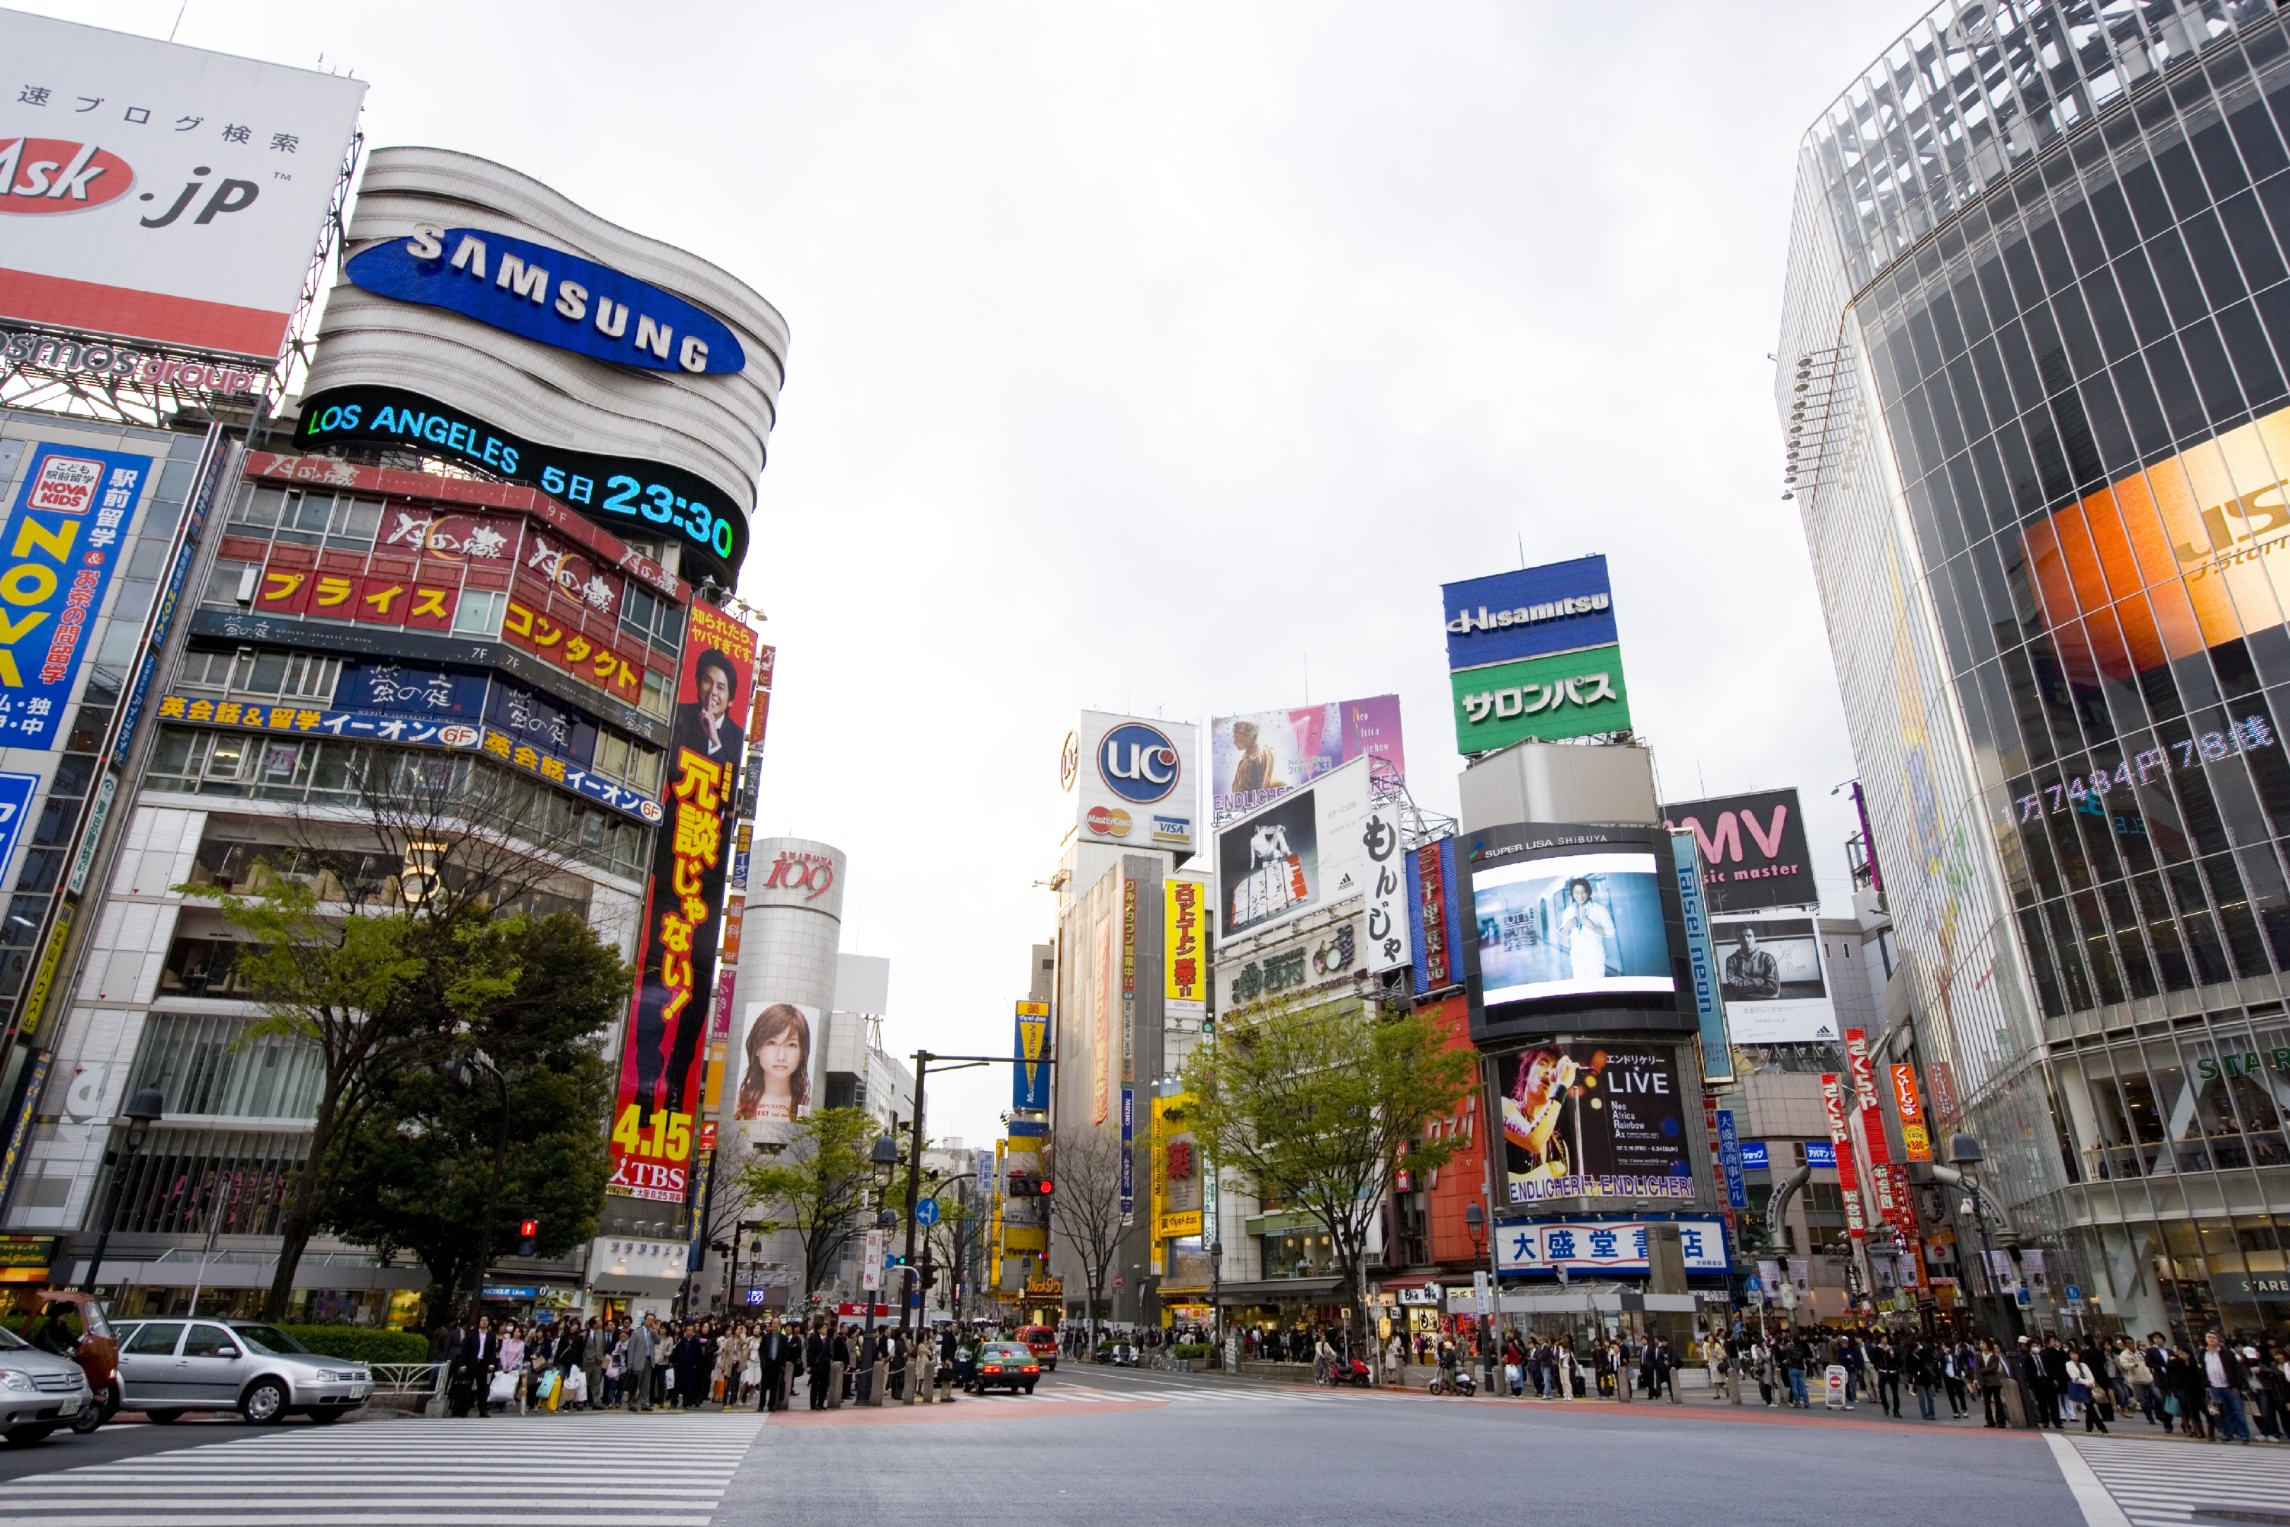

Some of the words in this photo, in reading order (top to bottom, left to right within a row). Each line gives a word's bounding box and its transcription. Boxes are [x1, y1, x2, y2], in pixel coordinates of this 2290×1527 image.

[406, 222, 709, 373] SAMSUNG
[141, 358, 252, 394] group
[44, 470, 95, 485] 駅前留学
[56, 462, 90, 475] こども
[307, 404, 360, 436] LOS
[370, 405, 519, 474] ANGELES
[541, 465, 594, 504] 5日
[602, 474, 732, 559] 23:30
[40, 481, 89, 497] NOVA
[40, 492, 83, 508] KIDS
[88, 468, 139, 548] 駅前留学
[549, 504, 568, 522] 9F
[265, 574, 447, 618] プライス
[692, 606, 754, 647] 知られたら、
[1447, 593, 1608, 633] Hisamitsu
[39, 570, 100, 685] お茶の間留学
[471, 648, 487, 659] 7F
[505, 602, 637, 688] コンタクト
[691, 625, 754, 665] ヤバすぎです。
[506, 655, 519, 668] 7F
[1462, 672, 1616, 722] サロンパス
[323, 714, 437, 742] イーオン
[443, 729, 472, 741] 6F
[484, 731, 566, 782] 英会話
[567, 771, 639, 810] イーオン
[643, 804, 659, 818] 6F
[1087, 814, 1131, 827] MasterCard
[1159, 823, 1184, 834] VISA
[1663, 804, 1787, 864] MV
[780, 851, 833, 867] SHIBUYA
[1485, 843, 1523, 858] SUPER
[1526, 839, 1553, 850] LISA
[1557, 834, 1607, 846] SHIBUYA
[763, 859, 833, 900] 109
[1363, 814, 1401, 962] もんじゃ
[1702, 871, 1725, 885] sic
[1734, 864, 1798, 881] master
[1678, 860, 1705, 939] Taisei
[727, 902, 743, 938] 歯科
[725, 952, 737, 960] 6F
[721, 971, 735, 979] 5F
[1690, 946, 1713, 1013] neon
[1027, 1003, 1039, 1014] 薬
[23, 1018, 35, 1029] 4F
[1606, 1055, 1665, 1065] エンドリケリー
[1607, 1072, 1670, 1094] LIVE
[1850, 1038, 1877, 1111] さくらや
[1611, 1100, 1627, 1110] Neo
[1612, 1110, 1635, 1120] Africa
[1823, 1082, 1848, 1145] さくらや
[612, 1103, 692, 1163] 4.15
[1613, 1120, 1645, 1130] Rainbow
[1165, 1141, 1190, 1180] 薬
[1720, 1116, 1743, 1203] 大盛堂商事ビル
[1742, 1149, 1764, 1160] ショップ
[630, 1162, 685, 1189] TBS
[983, 1154, 993, 1190] 渋谷駅前
[637, 1188, 650, 1199] 大阪
[651, 1189, 667, 1201] 8.25
[1510, 1175, 1586, 1202] ENDLICHERI
[1600, 1175, 1695, 1198] ENDLICHERI
[611, 1241, 685, 1256] 渋谷駅前ビル
[865, 1235, 877, 1285] 道玄坂
[852, 1304, 876, 1315] 宝く
